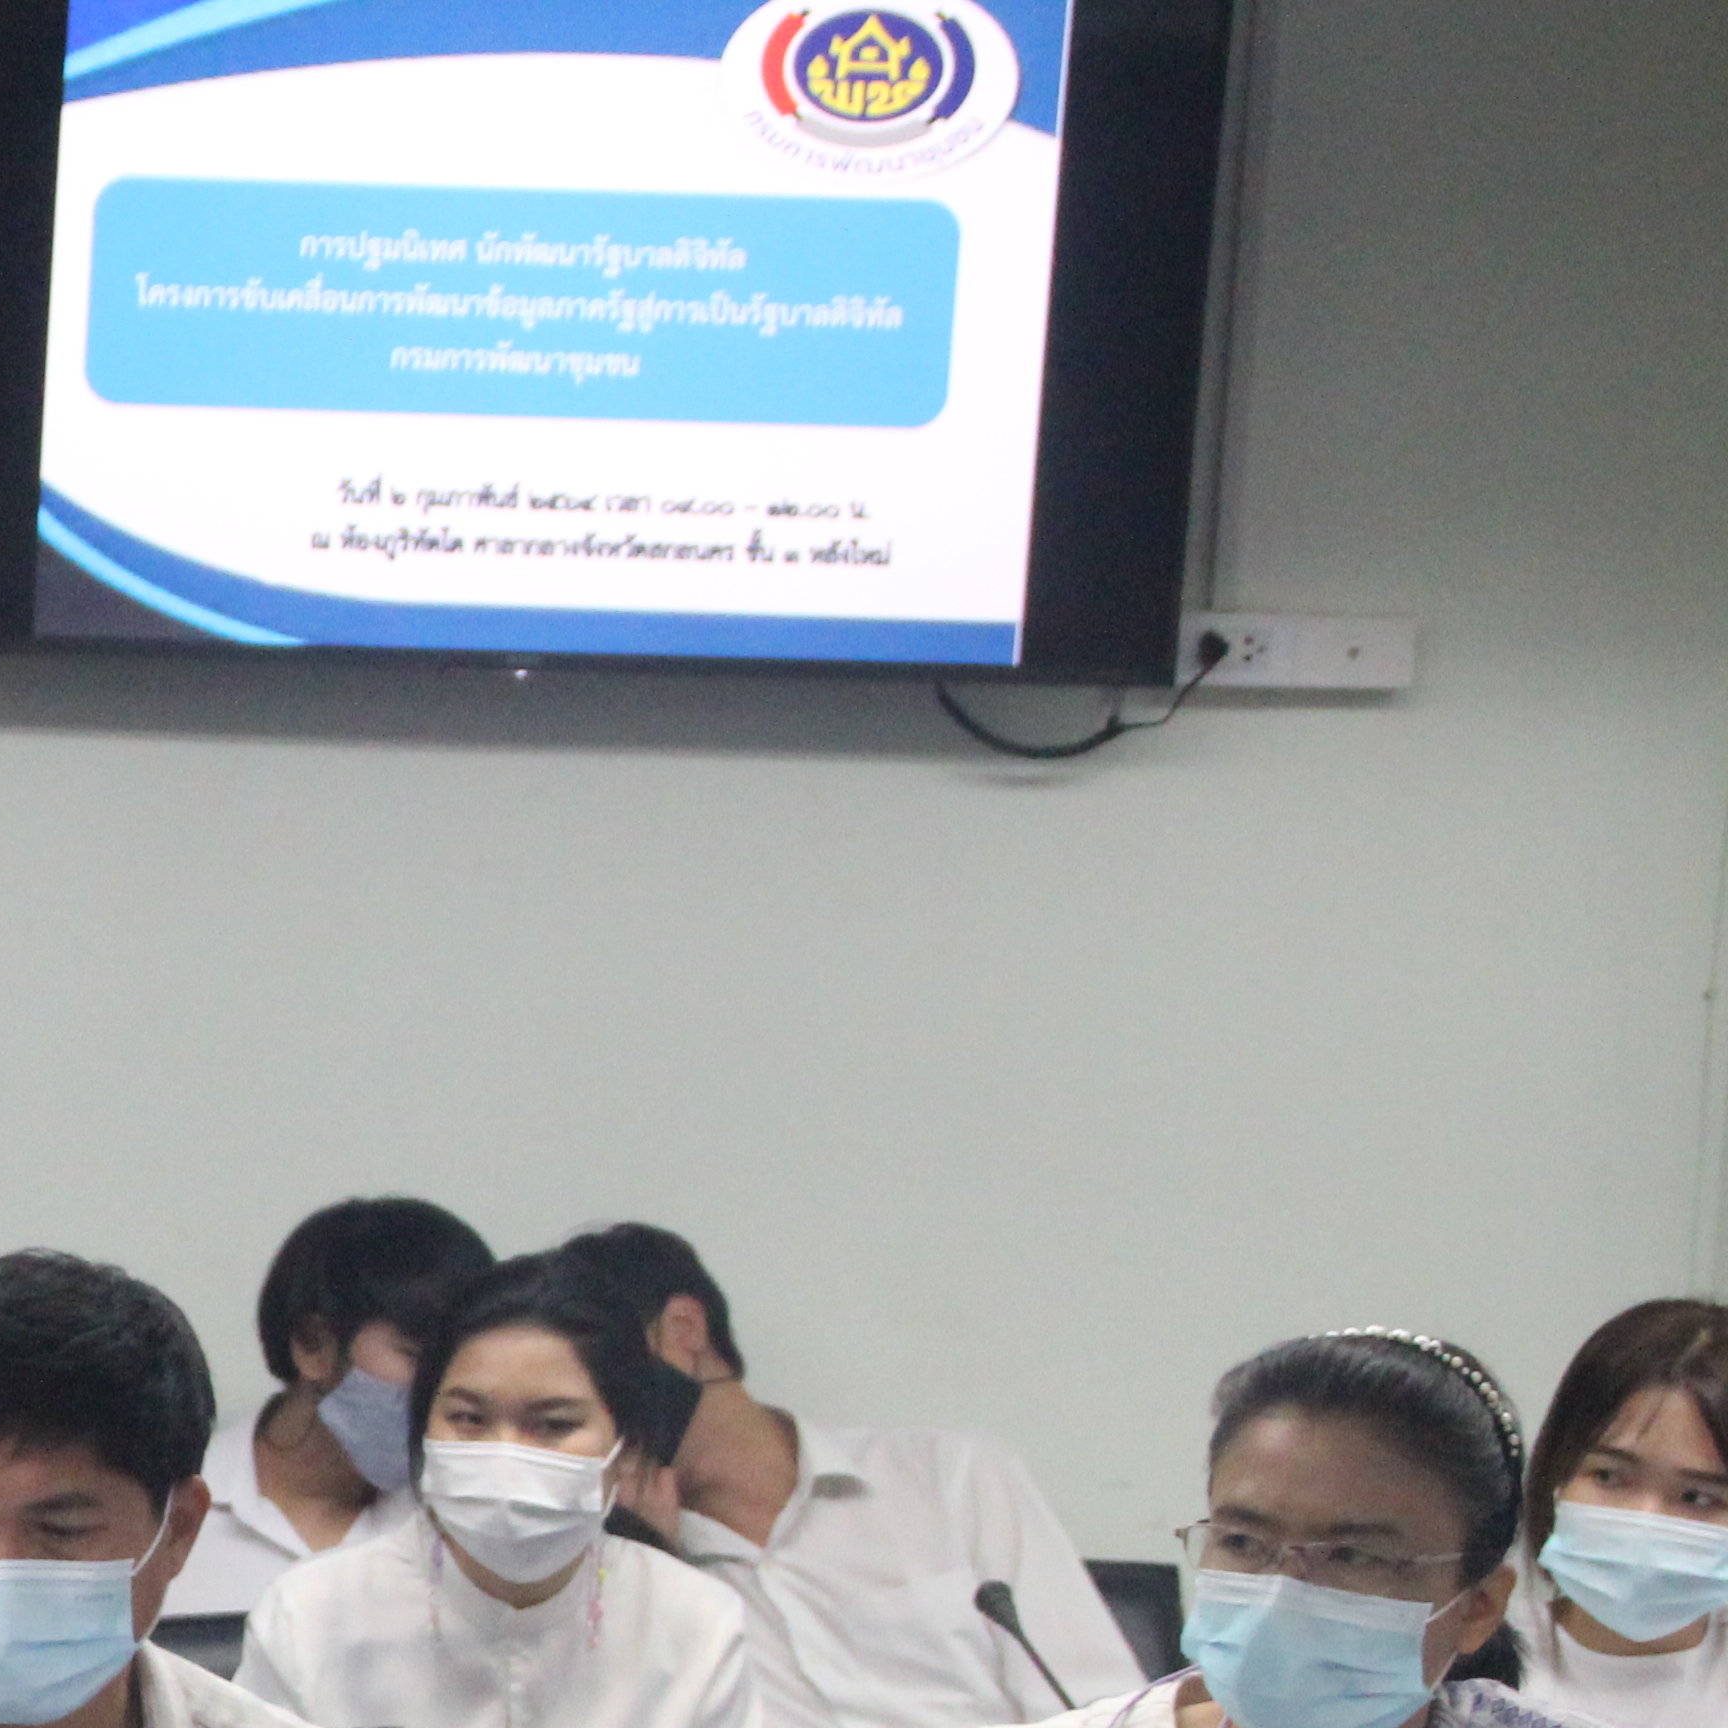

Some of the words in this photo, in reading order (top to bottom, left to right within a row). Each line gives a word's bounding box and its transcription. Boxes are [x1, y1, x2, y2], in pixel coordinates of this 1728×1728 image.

[299, 228, 468, 272] การปฐมนิเทศ
[475, 230, 747, 280] นักพัฒนารัฐบาลดิจิทัล
[390, 339, 642, 386] กรมการพัฒนาชุมชน
[338, 472, 383, 504] วันที่
[311, 530, 330, 550] ณ
